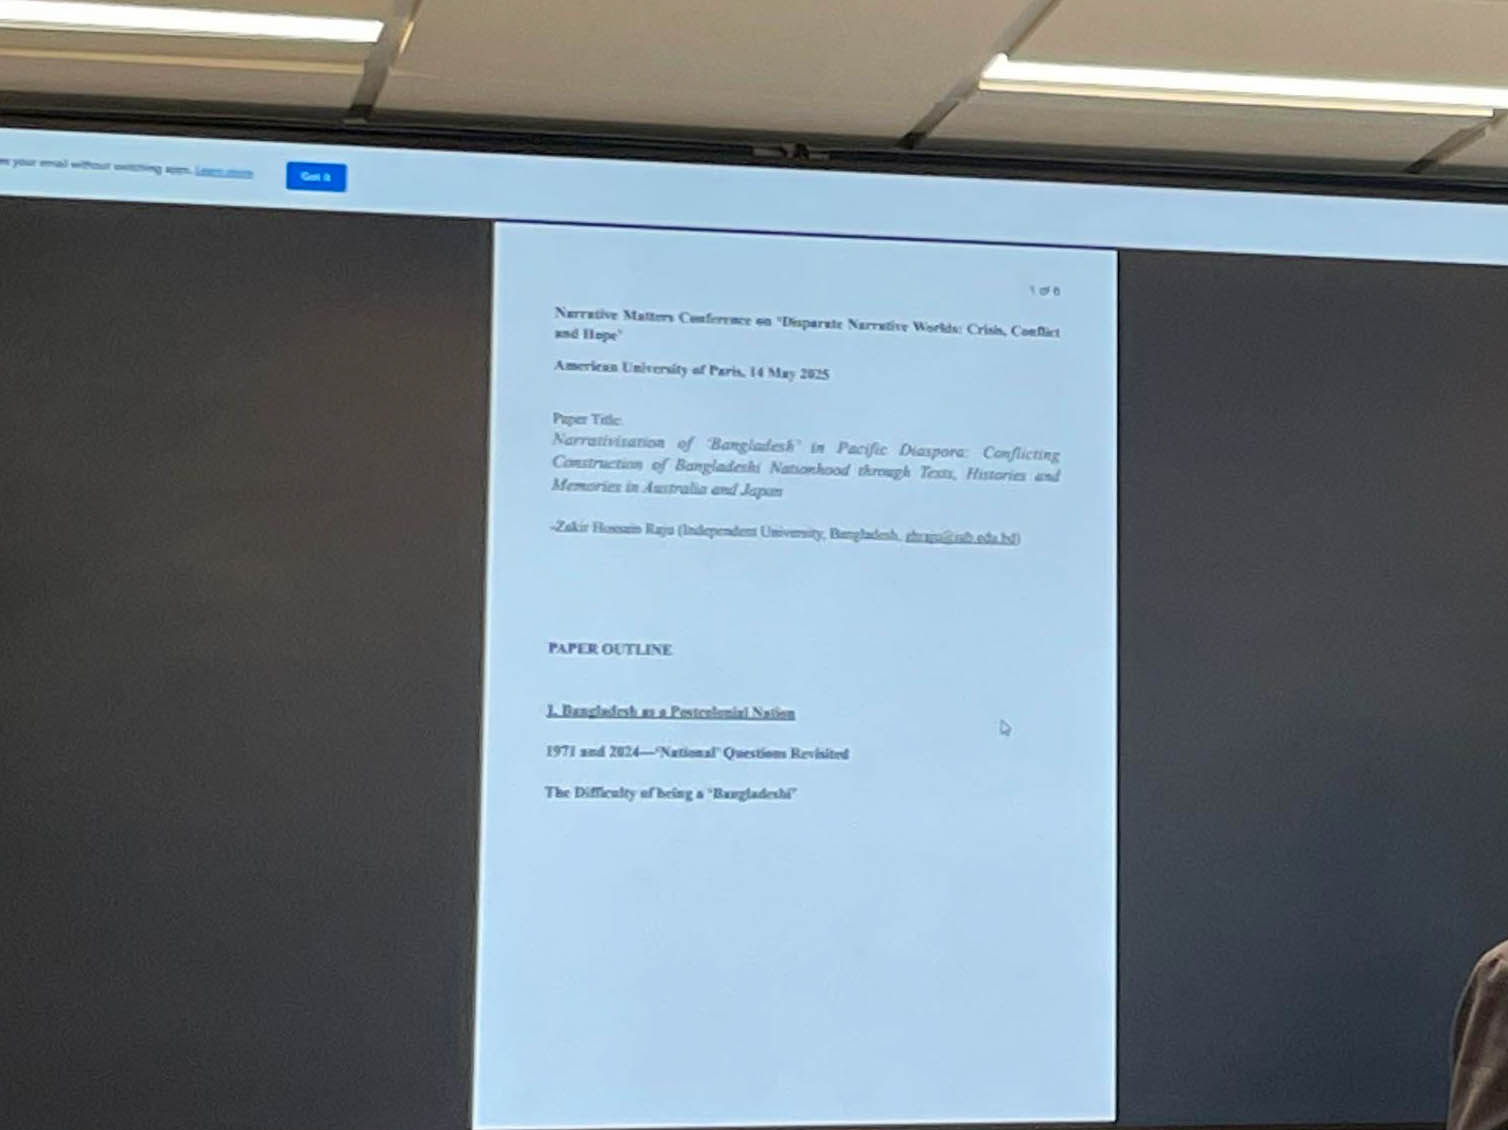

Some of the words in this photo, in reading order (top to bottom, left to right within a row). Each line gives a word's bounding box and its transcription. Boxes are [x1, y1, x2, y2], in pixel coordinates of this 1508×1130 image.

[39, 158, 68, 169] email
[554, 306, 618, 321] Narrative
[622, 309, 674, 323] Matters
[677, 311, 752, 327] Conference
[755, 316, 772, 327] on
[847, 317, 909, 333] Narrative
[1010, 324, 1061, 339] Conflict
[554, 328, 579, 340] and
[553, 359, 618, 373] American
[622, 361, 687, 379] University
[691, 363, 708, 375] of
[749, 366, 764, 378] 14
[767, 367, 796, 382] May
[799, 367, 830, 381] 2025
[552, 412, 588, 427] Paper
[552, 432, 665, 449] Narrativisation
[677, 435, 696, 453] of
[810, 441, 825, 455] in
[836, 441, 888, 459] Pacific
[982, 444, 1061, 464] Conflicting
[552, 454, 643, 472] Construction
[651, 457, 669, 474] of
[674, 458, 761, 477] Bangladeshi
[769, 460, 852, 477] Nationhood
[857, 464, 911, 481] through
[966, 467, 1027, 482] Histories
[1034, 469, 1061, 483] and
[551, 477, 622, 494] Memories
[625, 480, 640, 494] in
[643, 480, 708, 496] Australia
[710, 482, 736, 496] and
[739, 482, 784, 500] Japan
[549, 642, 600, 656] PAPER
[601, 643, 673, 657] OUTLINE
[562, 704, 638, 720] Bangladesh
[641, 708, 656, 720] as
[658, 708, 668, 720] a
[670, 705, 749, 720] Postcolonial
[751, 706, 796, 721] Nation
[546, 744, 576, 758] 1971
[579, 744, 606, 758] and
[722, 746, 787, 762] Questions
[790, 746, 850, 761] Revisited
[545, 785, 571, 799] The
[574, 785, 637, 802] Difficulty
[640, 786, 656, 799] of
[656, 786, 694, 802] being
[696, 789, 705, 800] a
